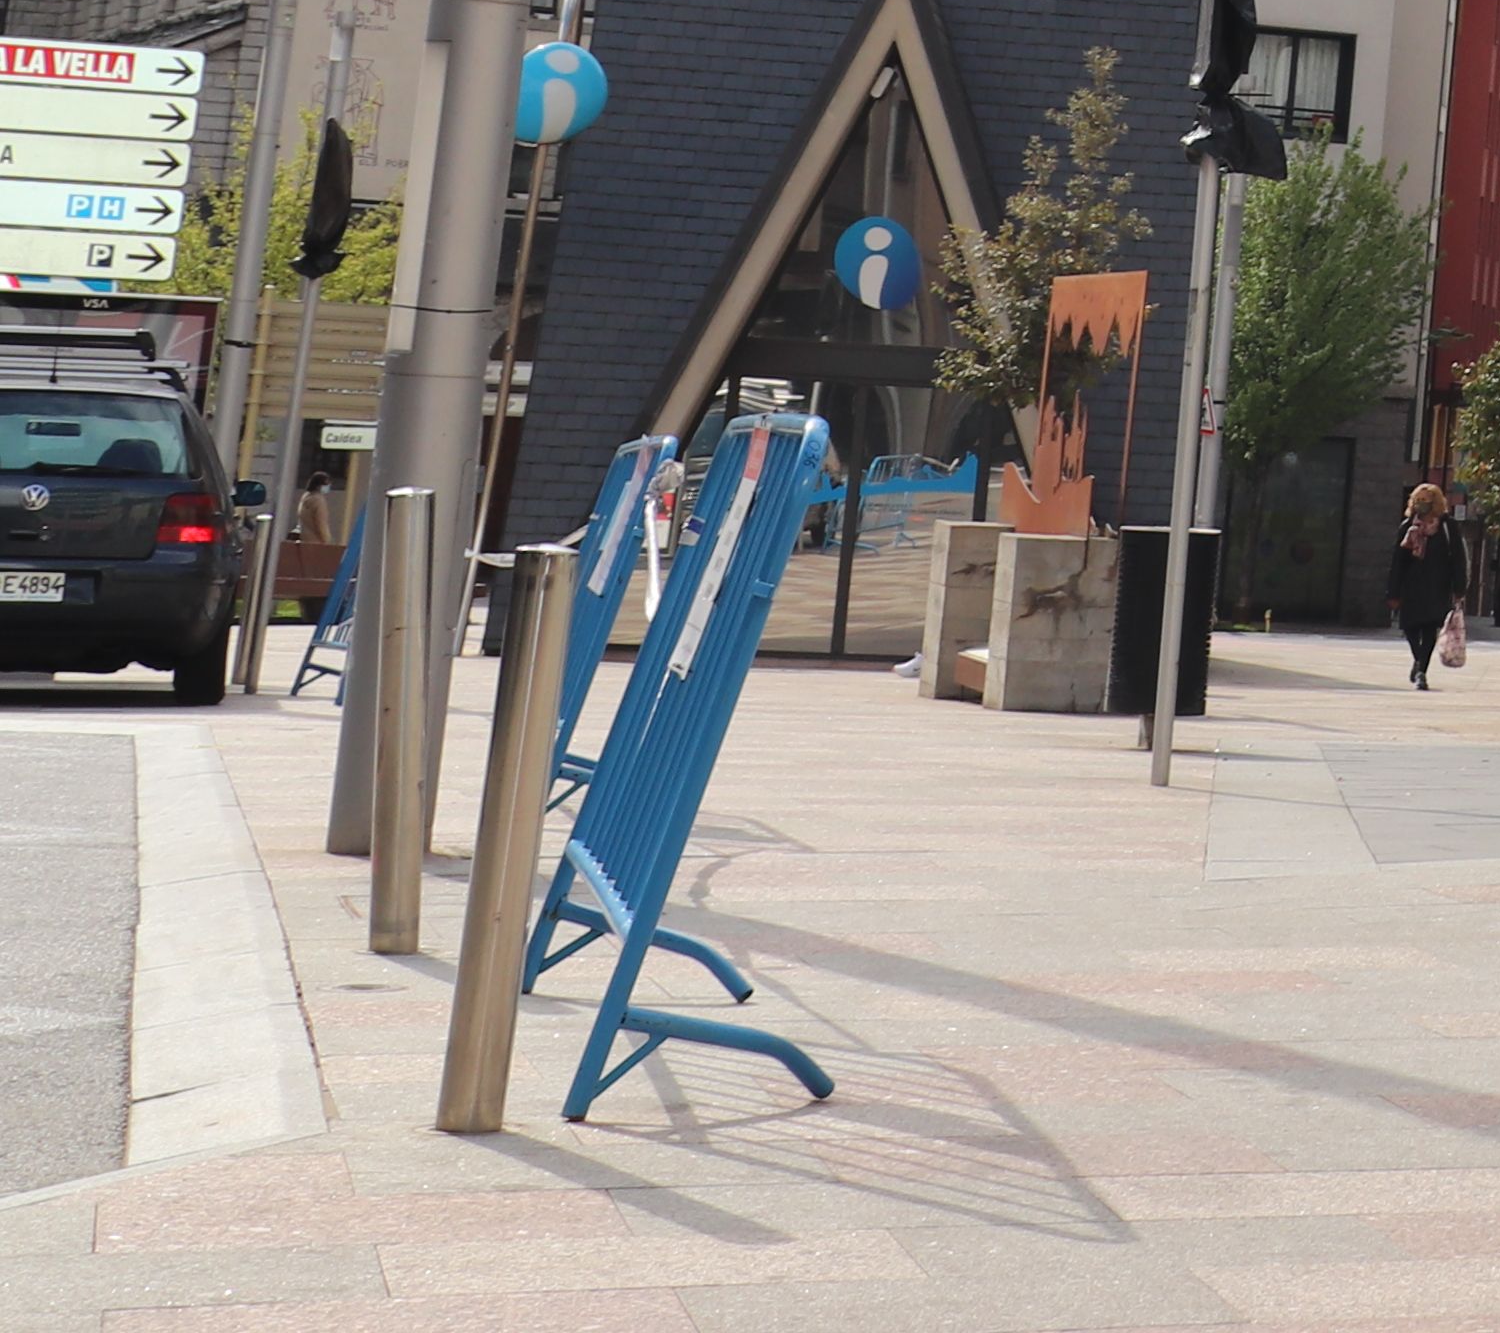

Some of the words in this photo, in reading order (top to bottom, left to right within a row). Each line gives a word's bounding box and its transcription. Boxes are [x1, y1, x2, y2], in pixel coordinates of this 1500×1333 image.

[13, 48, 46, 74] LA
[53, 51, 129, 80] VELLA
[70, 196, 90, 215] P
[102, 199, 121, 217] H
[91, 245, 109, 267] P
